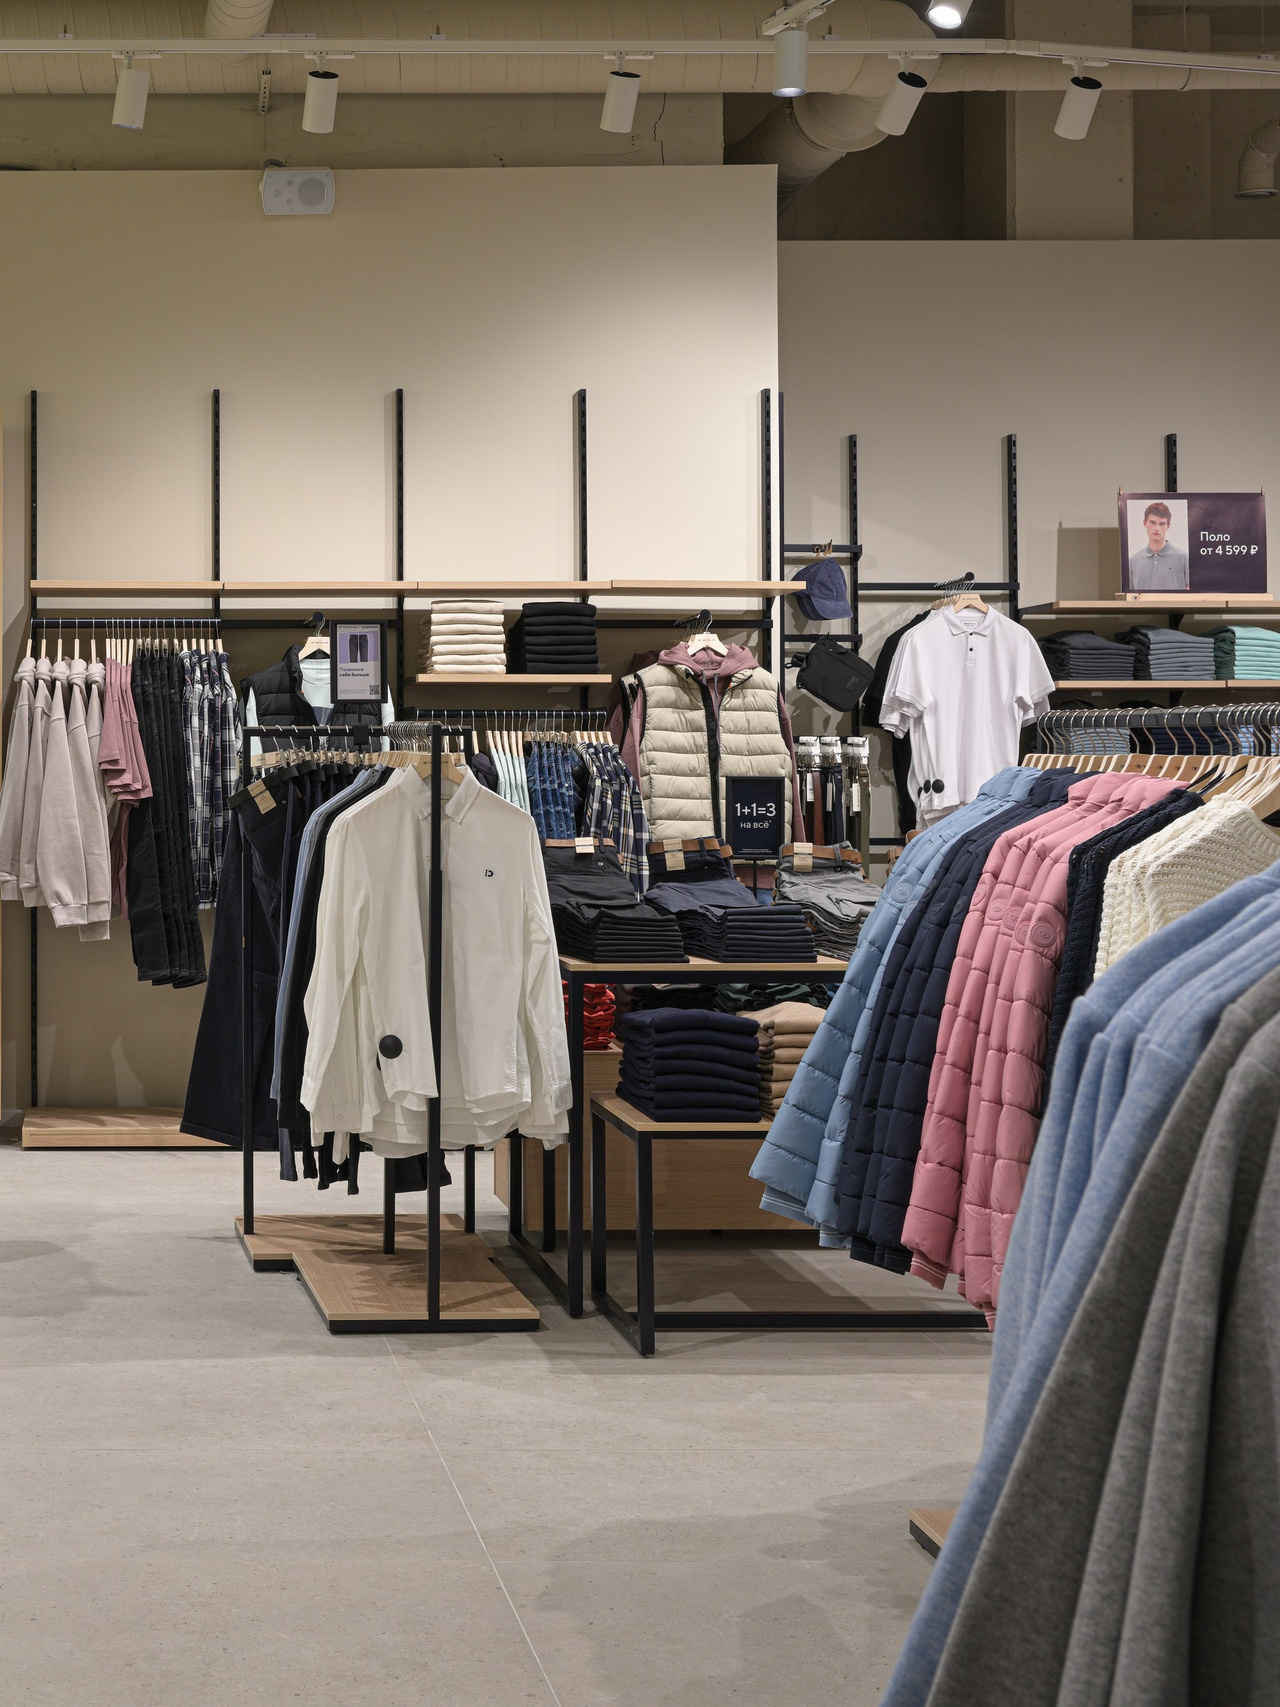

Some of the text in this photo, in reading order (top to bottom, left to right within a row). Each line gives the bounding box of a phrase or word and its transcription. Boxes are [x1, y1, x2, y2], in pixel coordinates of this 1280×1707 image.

[1200, 531, 1231, 541] Поло
[1200, 547, 1213, 555] от
[735, 802, 776, 817] 1+1=3
